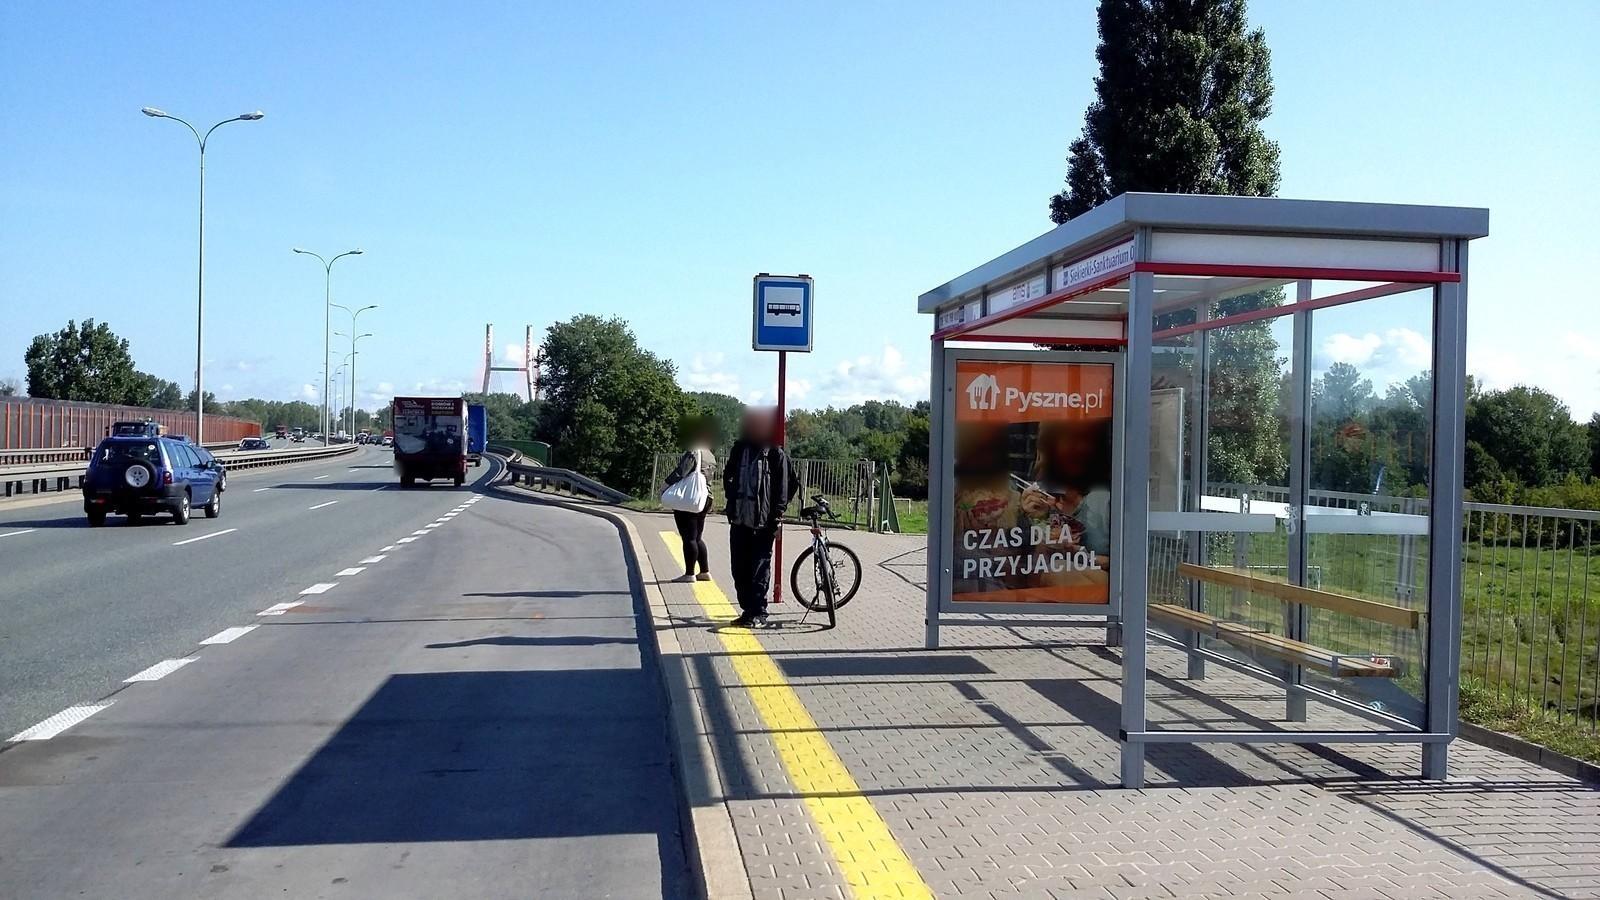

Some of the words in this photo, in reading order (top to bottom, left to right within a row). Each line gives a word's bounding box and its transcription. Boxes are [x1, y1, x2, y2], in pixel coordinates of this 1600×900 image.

[1005, 387, 1103, 413] Pyszne.pl
[963, 528, 1023, 551] CZAS
[1030, 523, 1073, 546] DLA
[963, 546, 1102, 580] PRZYJACIÓŁ
